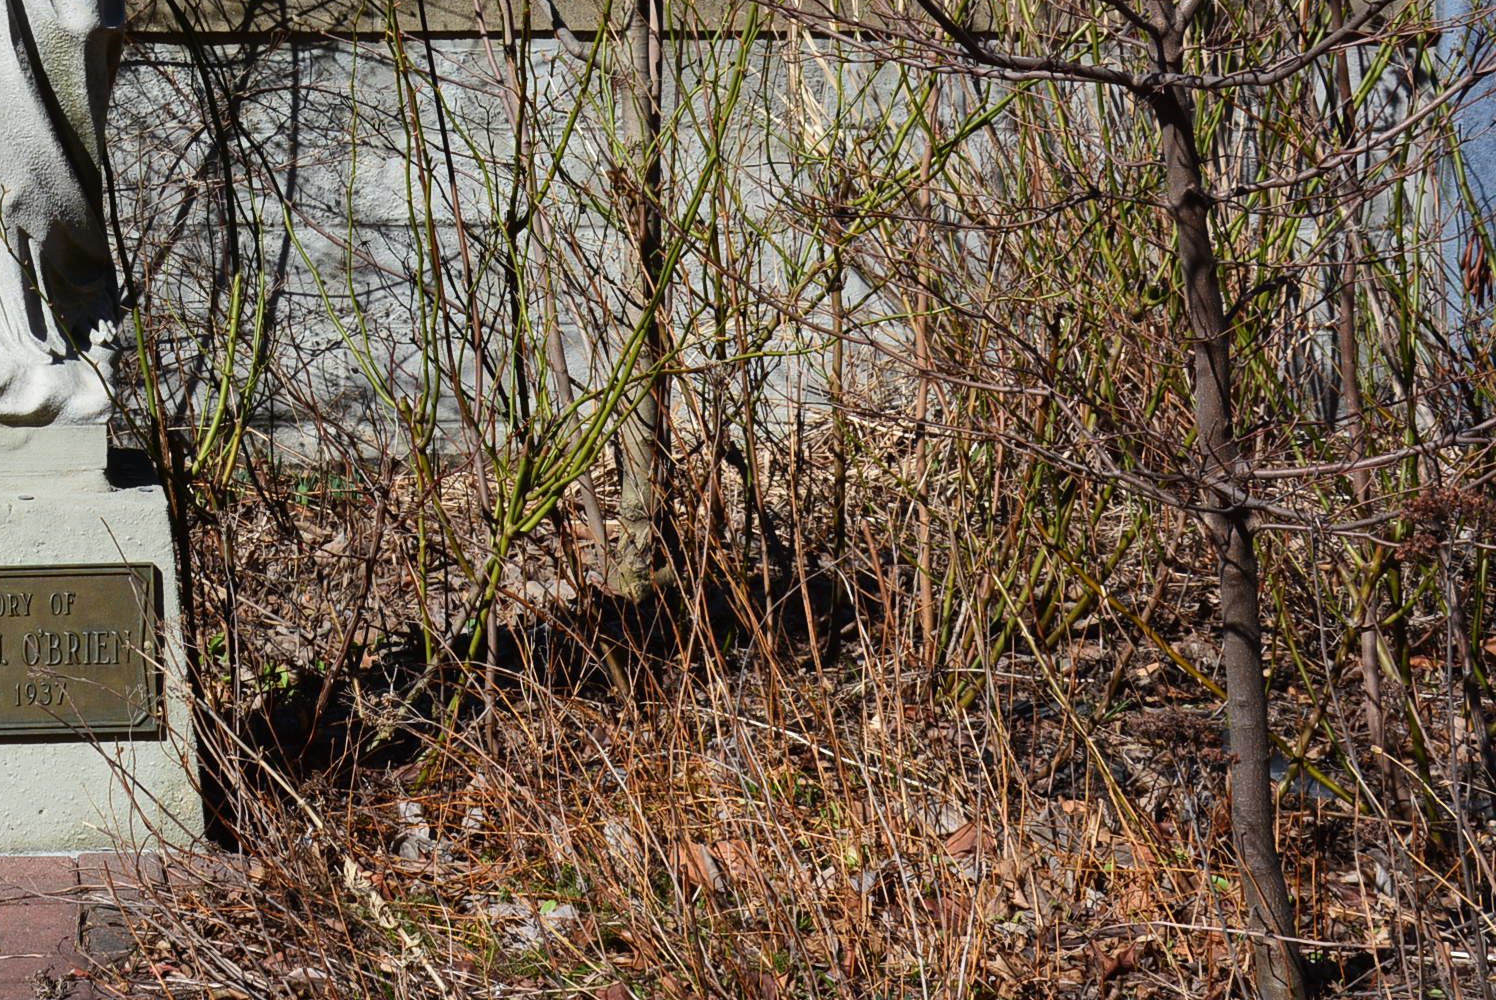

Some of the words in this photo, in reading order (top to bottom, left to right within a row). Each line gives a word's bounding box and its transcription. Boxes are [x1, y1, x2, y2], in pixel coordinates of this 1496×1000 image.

[49, 591, 77, 617] OF
[22, 628, 132, 668] O'BRIEN
[14, 681, 68, 707] 1937
